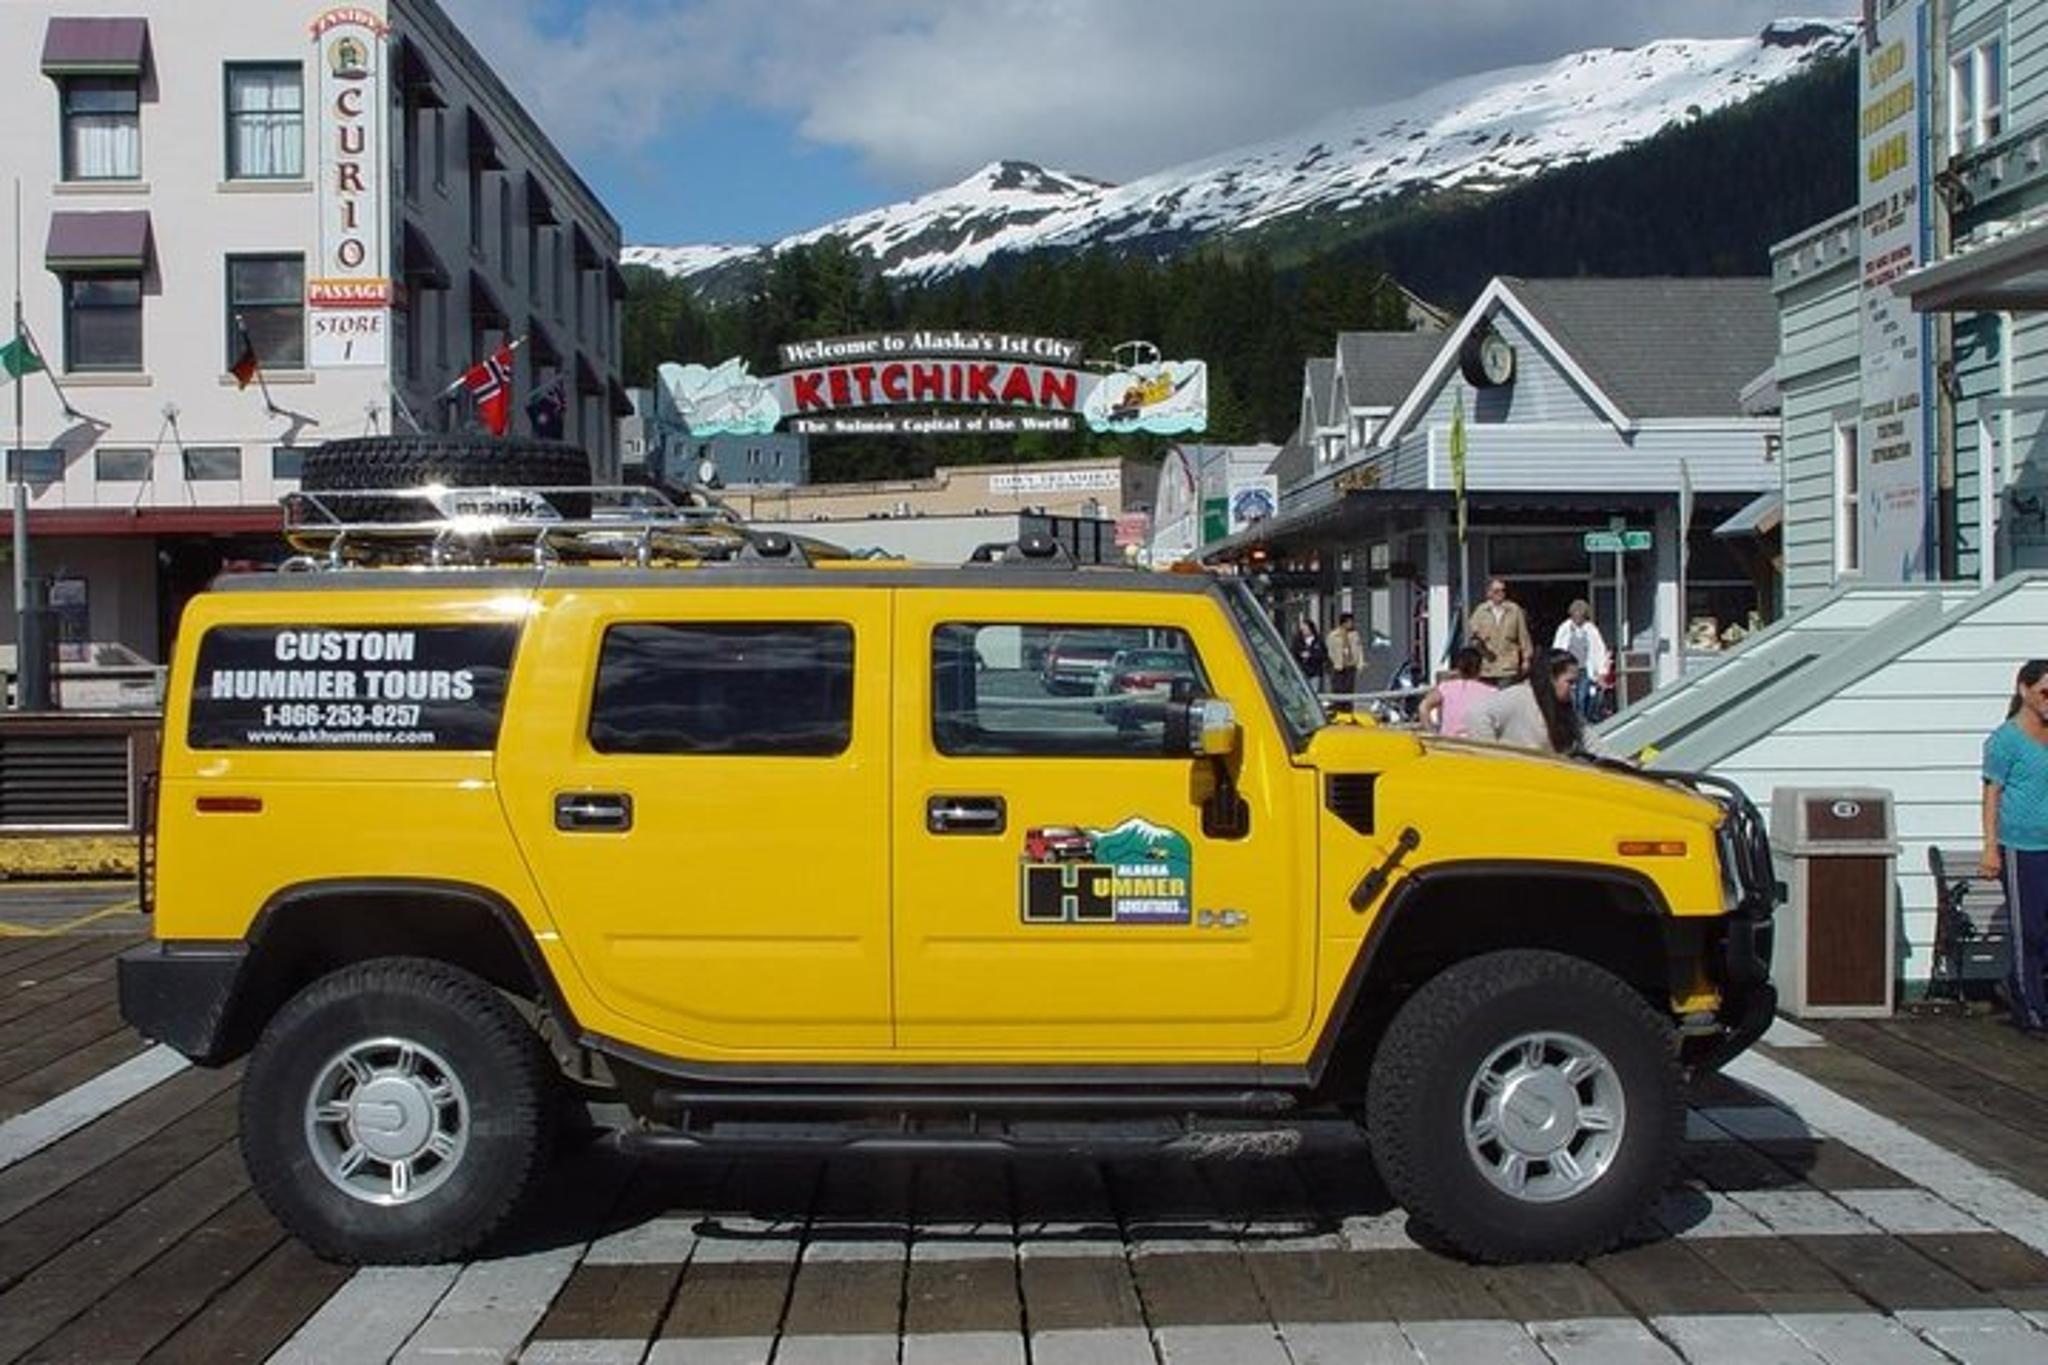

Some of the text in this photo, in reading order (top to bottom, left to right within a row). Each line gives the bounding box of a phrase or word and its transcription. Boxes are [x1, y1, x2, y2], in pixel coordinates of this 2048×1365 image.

[335, 88, 366, 268] CURIO
[310, 283, 385, 299] PASSAGE
[315, 315, 381, 335] STORE
[785, 340, 878, 361] Welcome
[883, 336, 905, 351] to
[909, 331, 993, 351] Alaska's
[1034, 337, 1075, 362] City
[793, 362, 1077, 410] KETCHIKAN
[797, 417, 1070, 433] The Salmon Capital of the World
[275, 631, 415, 661] CUSTOM
[212, 670, 474, 700] HUMMER TOURS
[247, 729, 436, 744] www.akhummer.com
